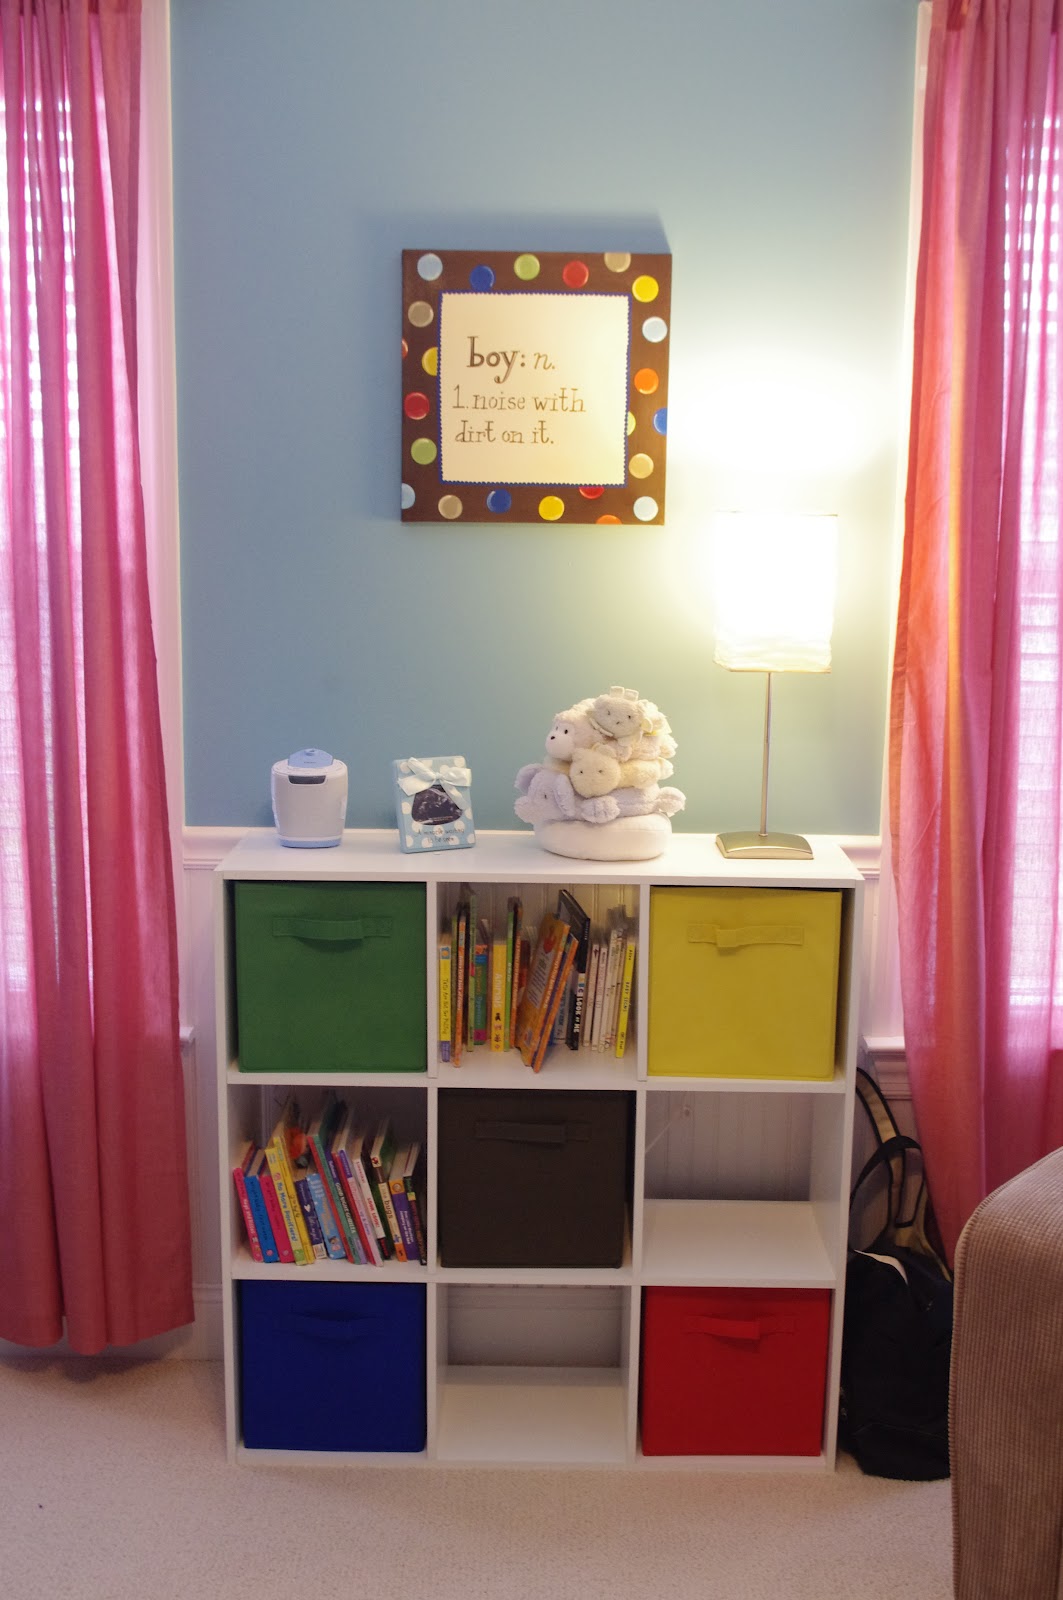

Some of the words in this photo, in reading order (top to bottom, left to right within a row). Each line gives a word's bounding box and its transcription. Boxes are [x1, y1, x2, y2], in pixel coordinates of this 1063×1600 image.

[466, 336, 526, 384] boy:
[533, 351, 556, 370] n.
[531, 388, 586, 413] with
[454, 420, 496, 443] dirt
[501, 429, 524, 444] on
[530, 420, 555, 445] it.
[494, 973, 502, 1007] Animals
[575, 996, 583, 1014] LOOK
[573, 1023, 580, 1033] ME
[279, 1192, 288, 1208] More
[366, 1196, 374, 1211] LOOK
[383, 1199, 395, 1219] bugs
[344, 1211, 356, 1234] GORILLA
